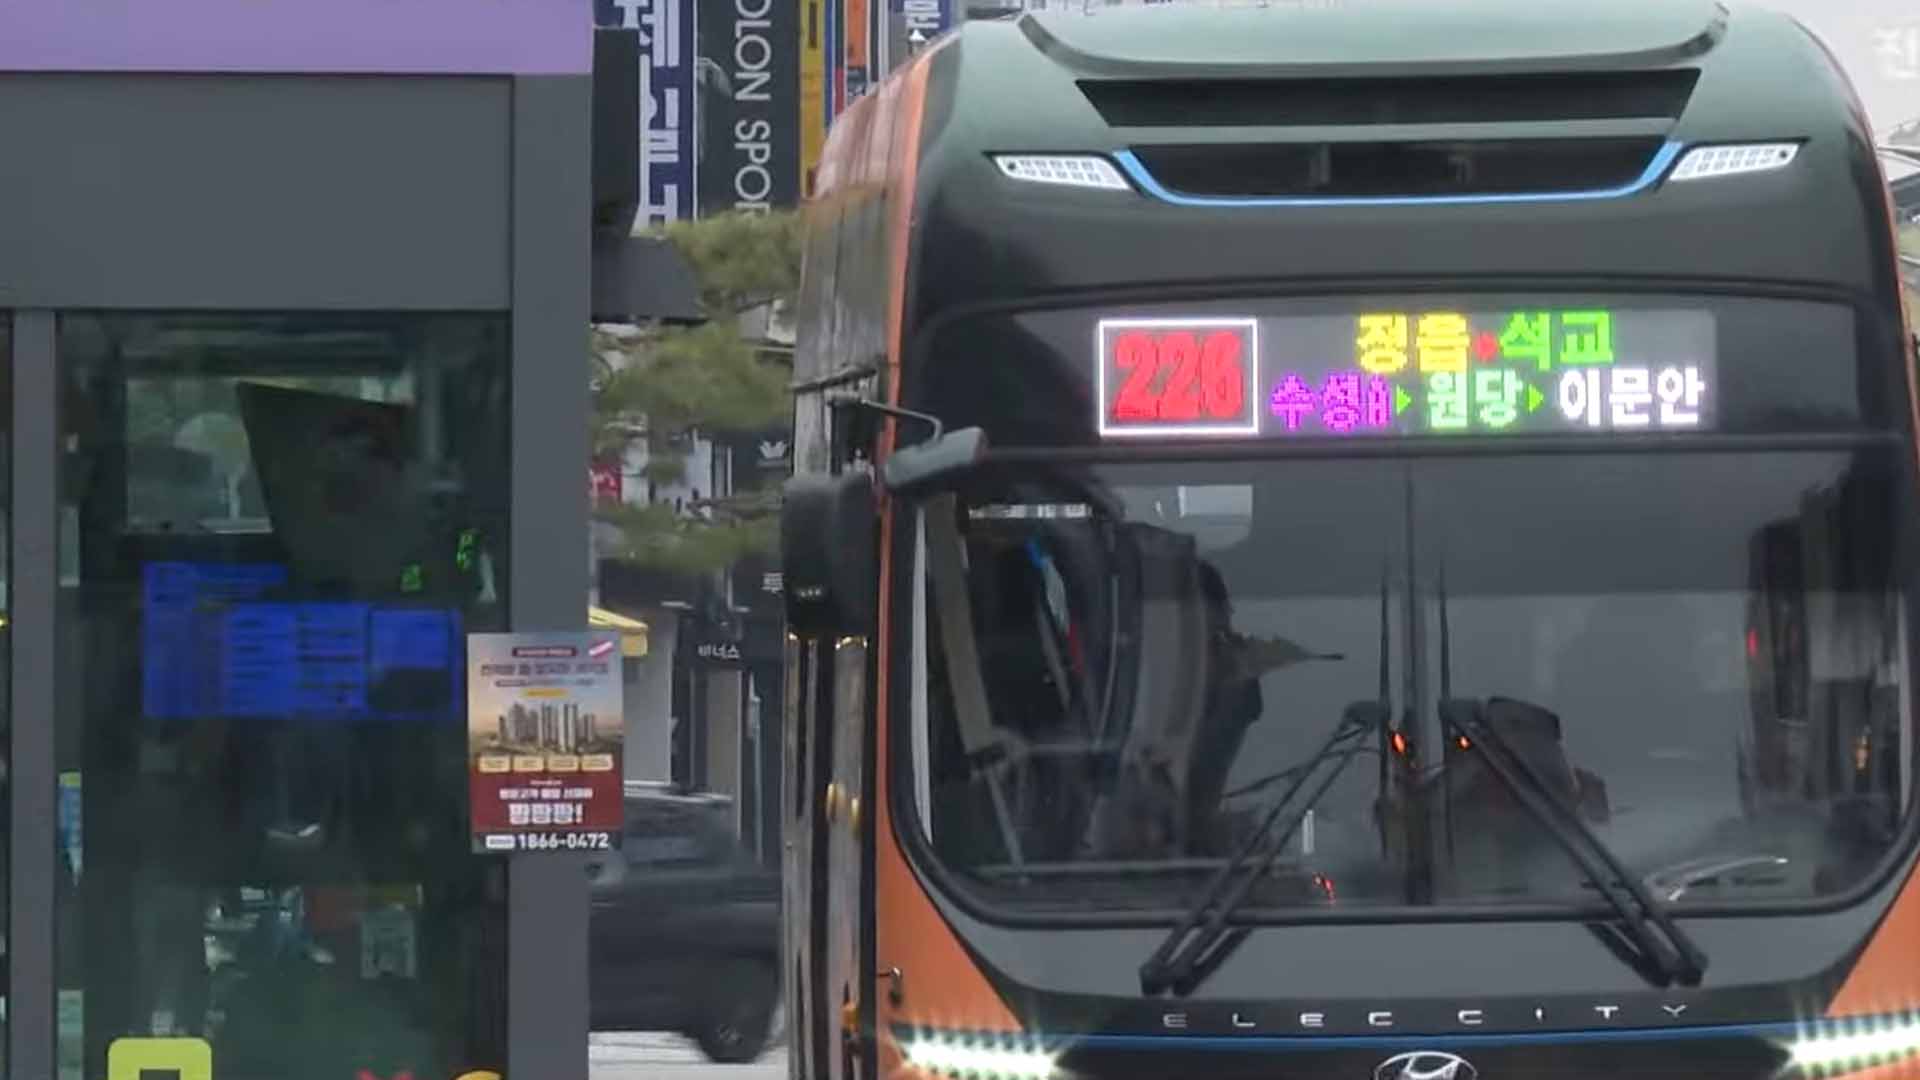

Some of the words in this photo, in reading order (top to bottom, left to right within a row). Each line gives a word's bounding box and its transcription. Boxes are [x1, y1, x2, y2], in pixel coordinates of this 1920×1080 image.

[1357, 313, 1469, 373] 정읍
[1500, 311, 1613, 369] 석교
[1112, 331, 1244, 421] 226
[1427, 372, 1523, 427] 원당
[1559, 368, 1704, 425] 이문안
[697, 645, 741, 659] 비너스
[518, 833, 609, 849] 1866-0472
[1163, 1012, 1393, 1027] ELEC
[1457, 1005, 1687, 1025] CITY
